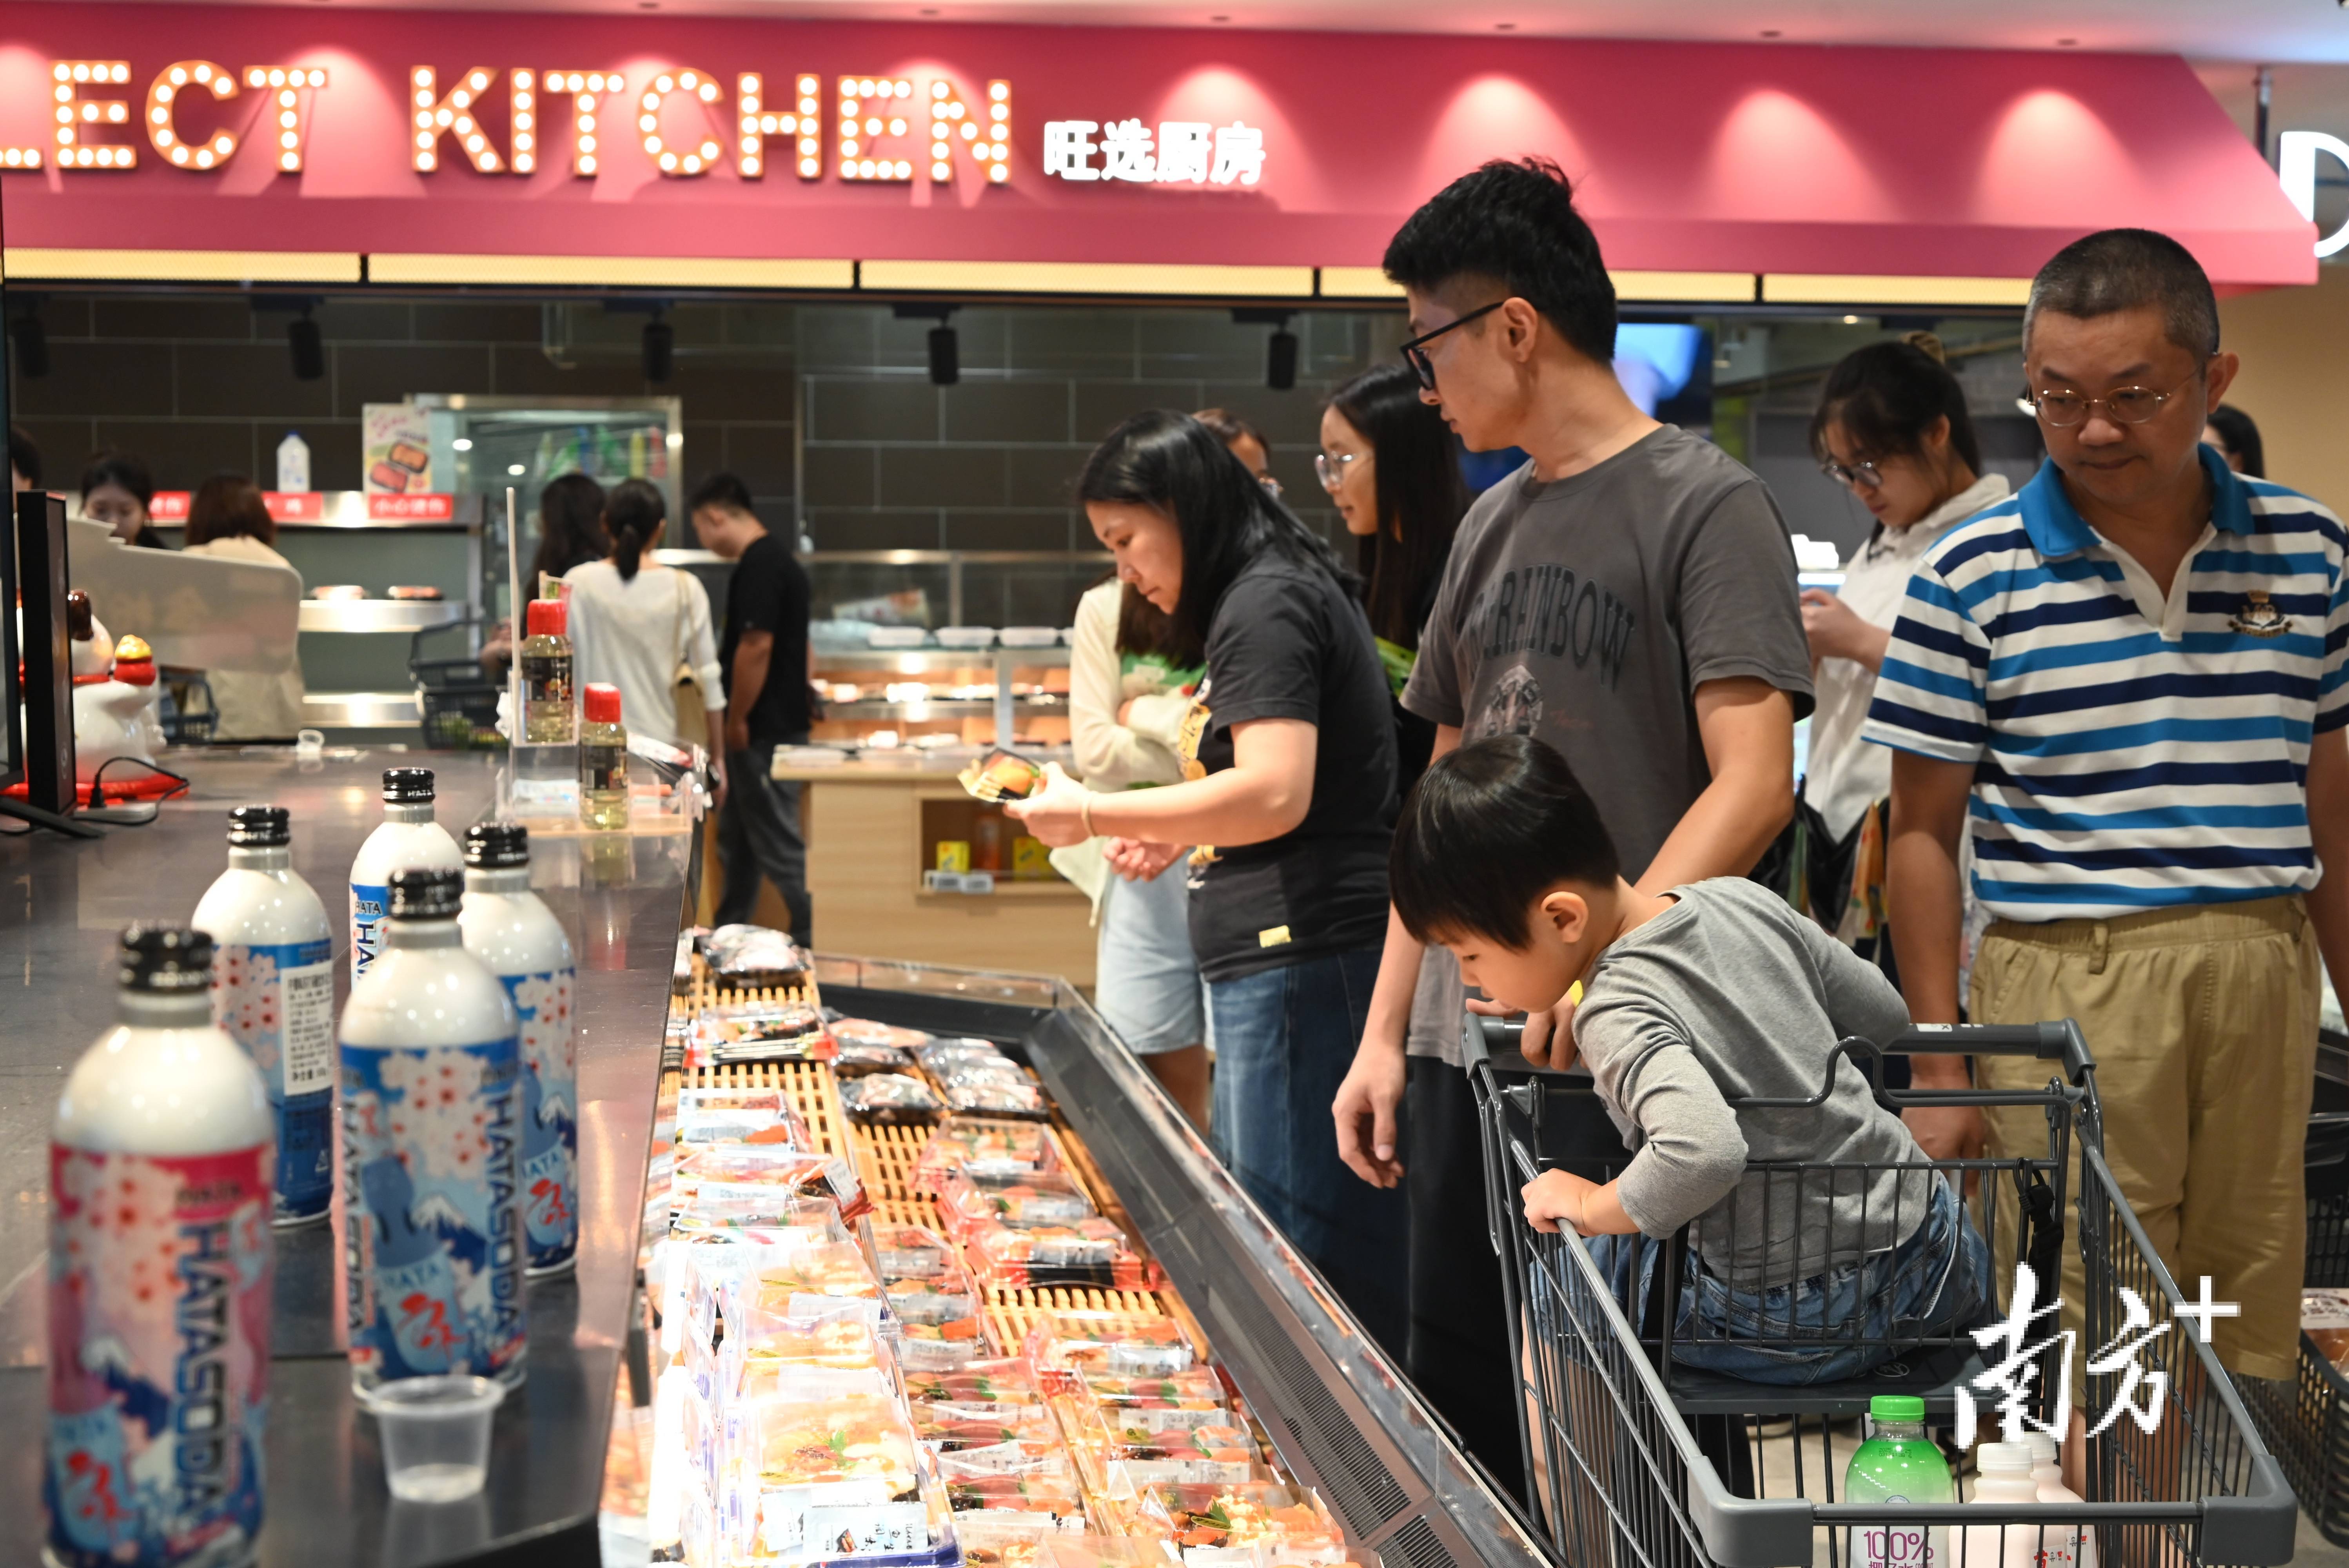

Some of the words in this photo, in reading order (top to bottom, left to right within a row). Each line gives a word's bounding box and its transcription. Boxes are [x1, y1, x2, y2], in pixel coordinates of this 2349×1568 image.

[411, 65, 1011, 184] KITCHEN
[1043, 118, 1265, 186] 旺选厨房
[1864, 1530, 1934, 1561] 100%
